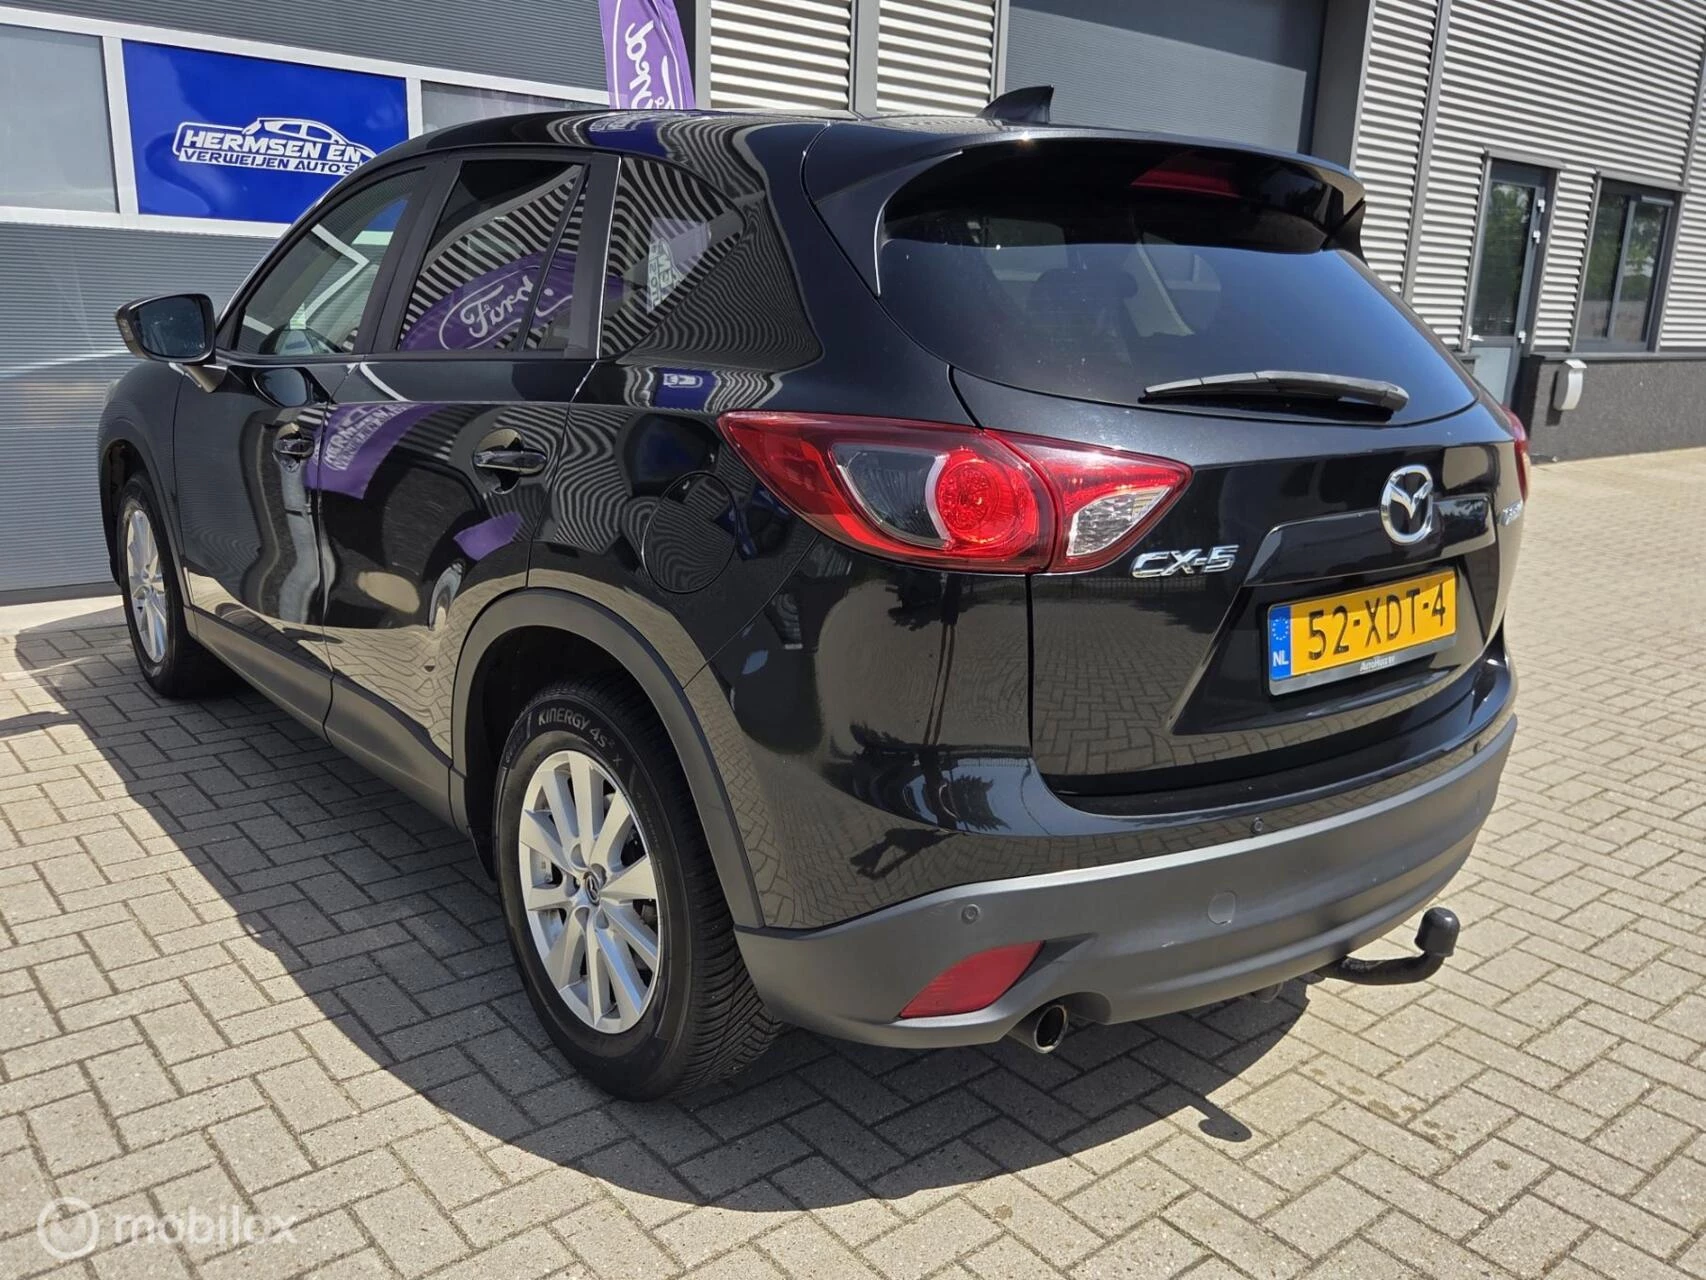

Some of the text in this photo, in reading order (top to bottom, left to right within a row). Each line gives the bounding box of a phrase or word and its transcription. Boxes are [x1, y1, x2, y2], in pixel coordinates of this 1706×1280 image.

[182, 129, 362, 162] HERMSEN EN
[184, 150, 357, 175] VERWEIJEN AUTO'S
[1131, 544, 1240, 578] CX-5
[1308, 582, 1446, 661] 52-XDT-4
[1272, 650, 1289, 667] NL
[538, 707, 591, 730] KINERGY
